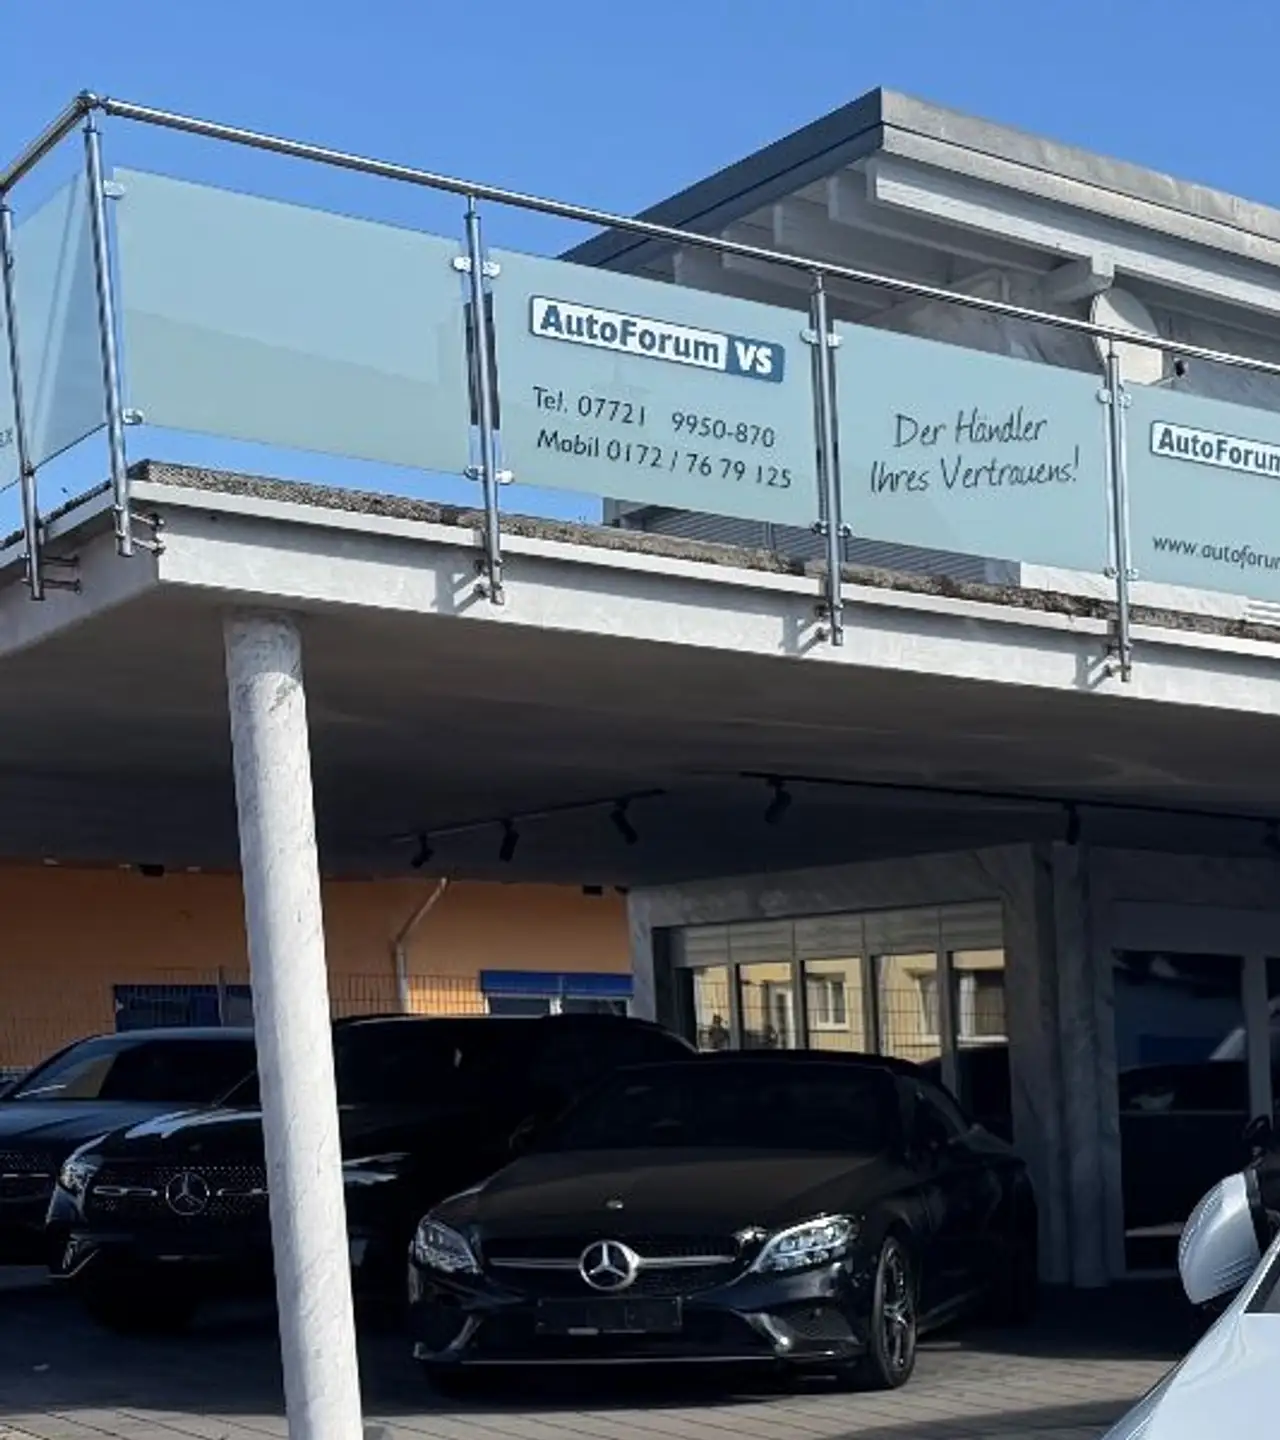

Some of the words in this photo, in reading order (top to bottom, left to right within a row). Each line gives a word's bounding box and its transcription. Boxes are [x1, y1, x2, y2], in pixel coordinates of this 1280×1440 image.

[540, 304, 720, 365] AutoForum
[733, 339, 773, 375] VS
[533, 386, 568, 413] Tel.
[577, 395, 646, 426] 07721
[671, 411, 776, 449] 9950-870
[892, 412, 947, 448] Der
[954, 404, 1048, 444] Händler
[536, 429, 600, 458] Mobil
[605, 441, 662, 468] 0172
[686, 453, 713, 477] 76
[720, 457, 746, 482] 79
[755, 465, 793, 489] 125
[870, 460, 930, 494] Ihres
[939, 444, 1080, 491] Vertrauens!
